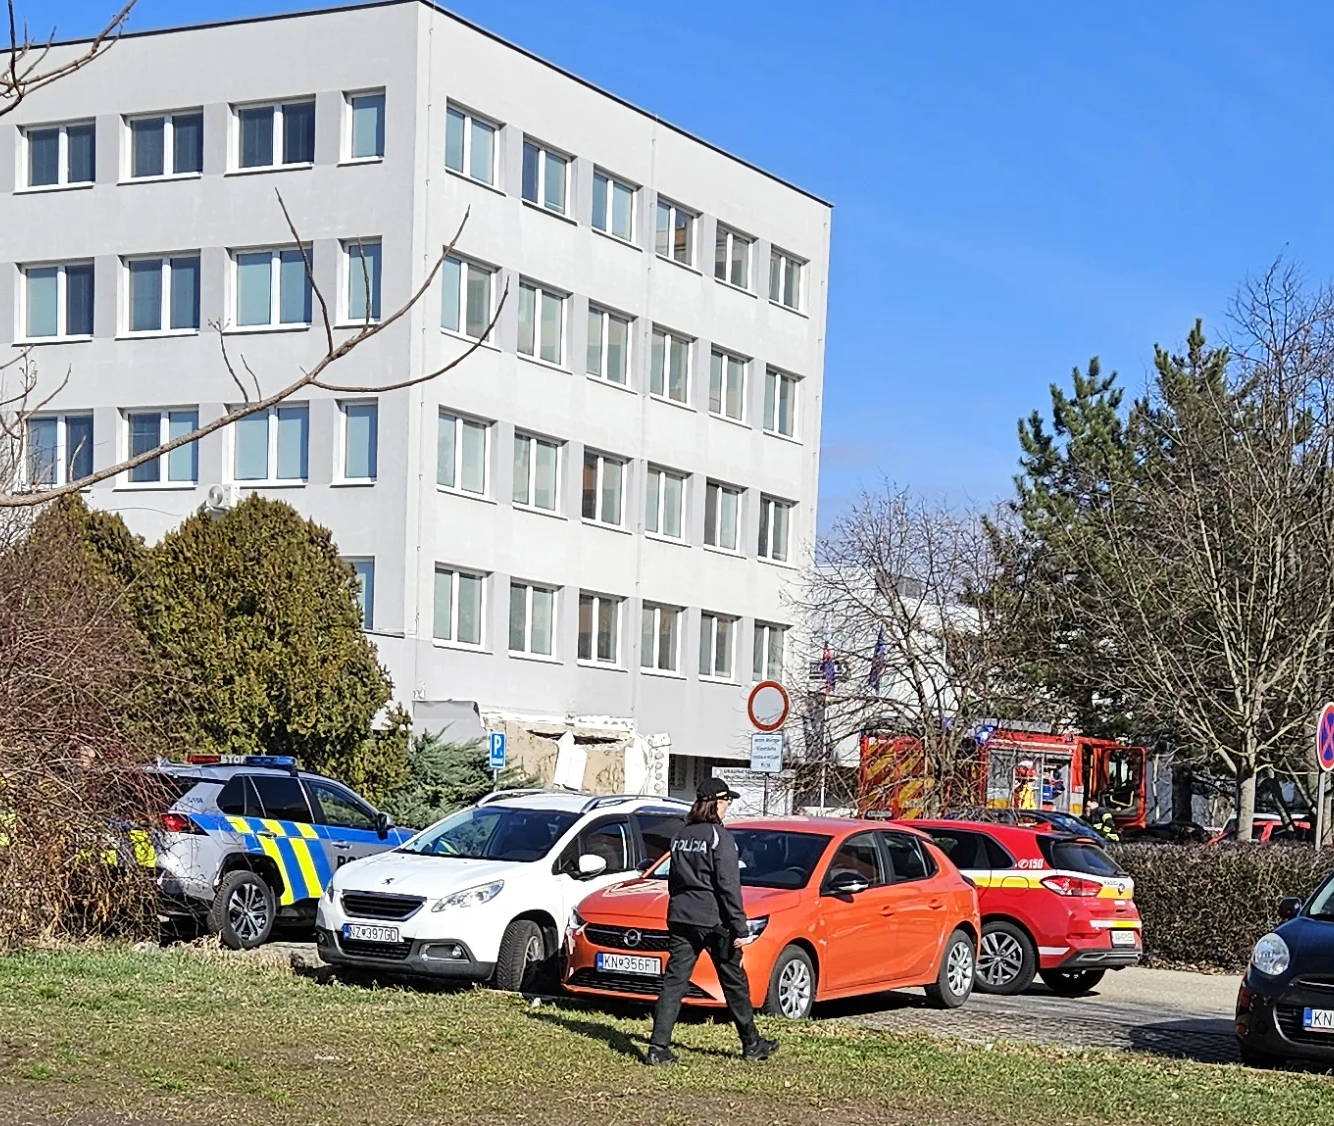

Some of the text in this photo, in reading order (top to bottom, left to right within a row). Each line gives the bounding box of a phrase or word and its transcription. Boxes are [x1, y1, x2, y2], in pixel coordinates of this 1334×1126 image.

[494, 735, 502, 755] P
[1028, 858, 1044, 869] 150
[603, 953, 618, 969] KN
[1313, 1011, 1333, 1026] KN
